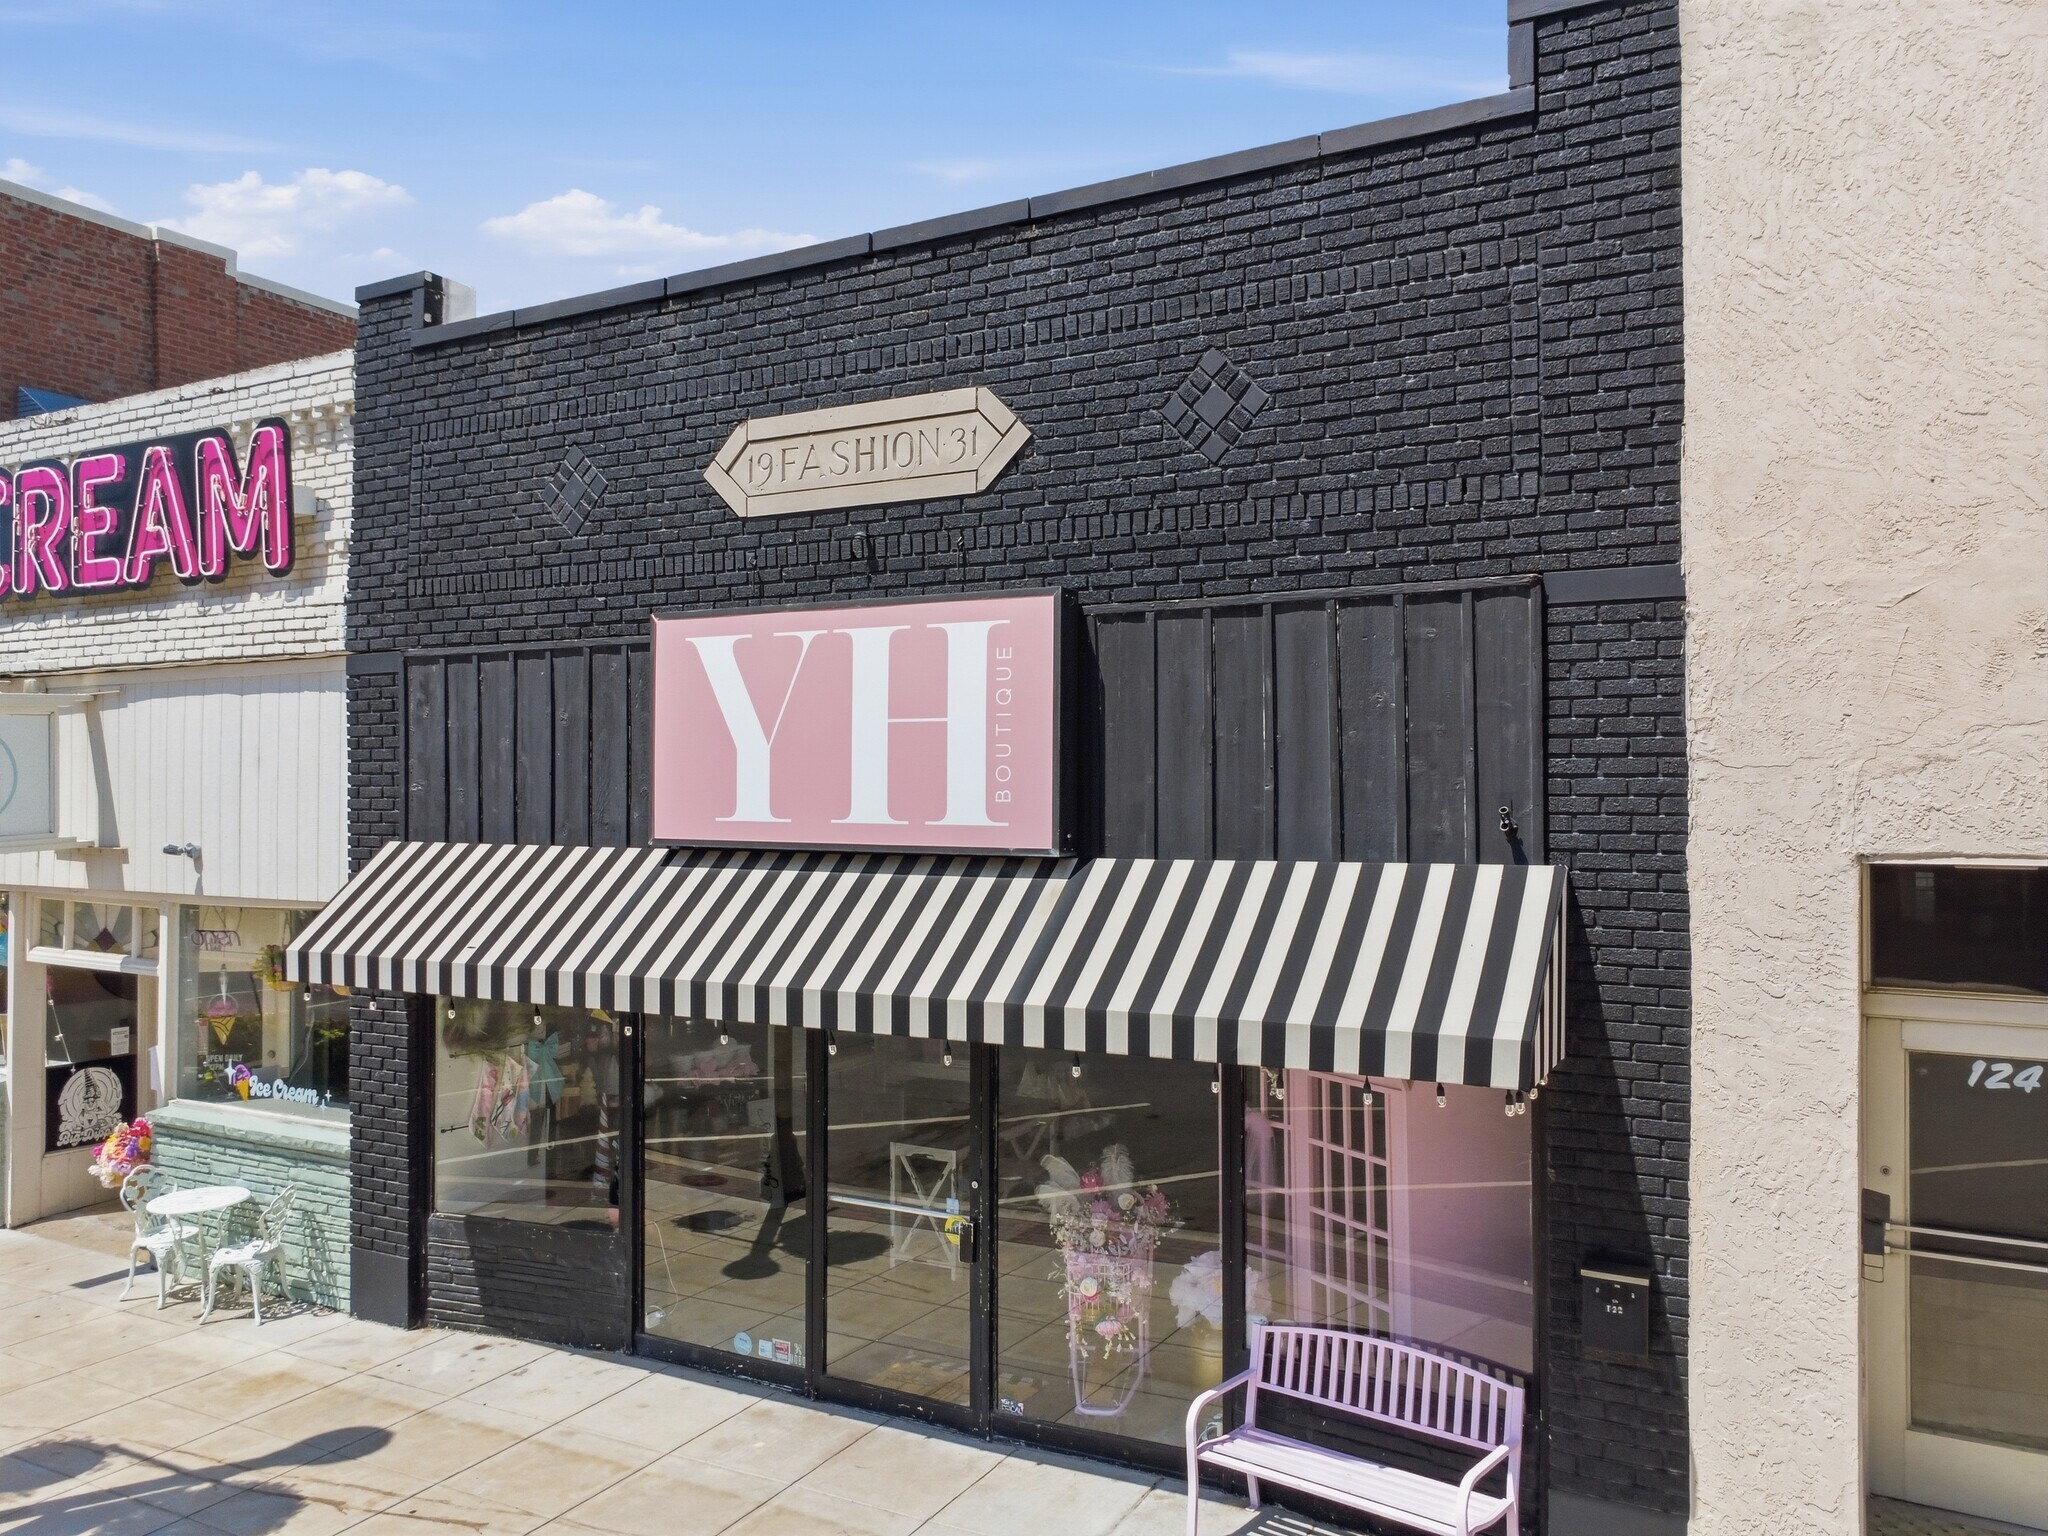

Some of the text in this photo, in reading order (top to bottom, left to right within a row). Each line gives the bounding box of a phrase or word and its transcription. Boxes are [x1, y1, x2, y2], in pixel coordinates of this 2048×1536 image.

[780, 427, 940, 482] FASHION
[948, 425, 979, 464] 31
[0, 425, 291, 600] REAM
[685, 619, 1011, 827] YH
[995, 645, 1013, 803] BOUTIQUE
[249, 1075, 320, 1105] Ice Cream
[1967, 1059, 2045, 1094] 124
[56, 1126, 113, 1147] Big Dipp
